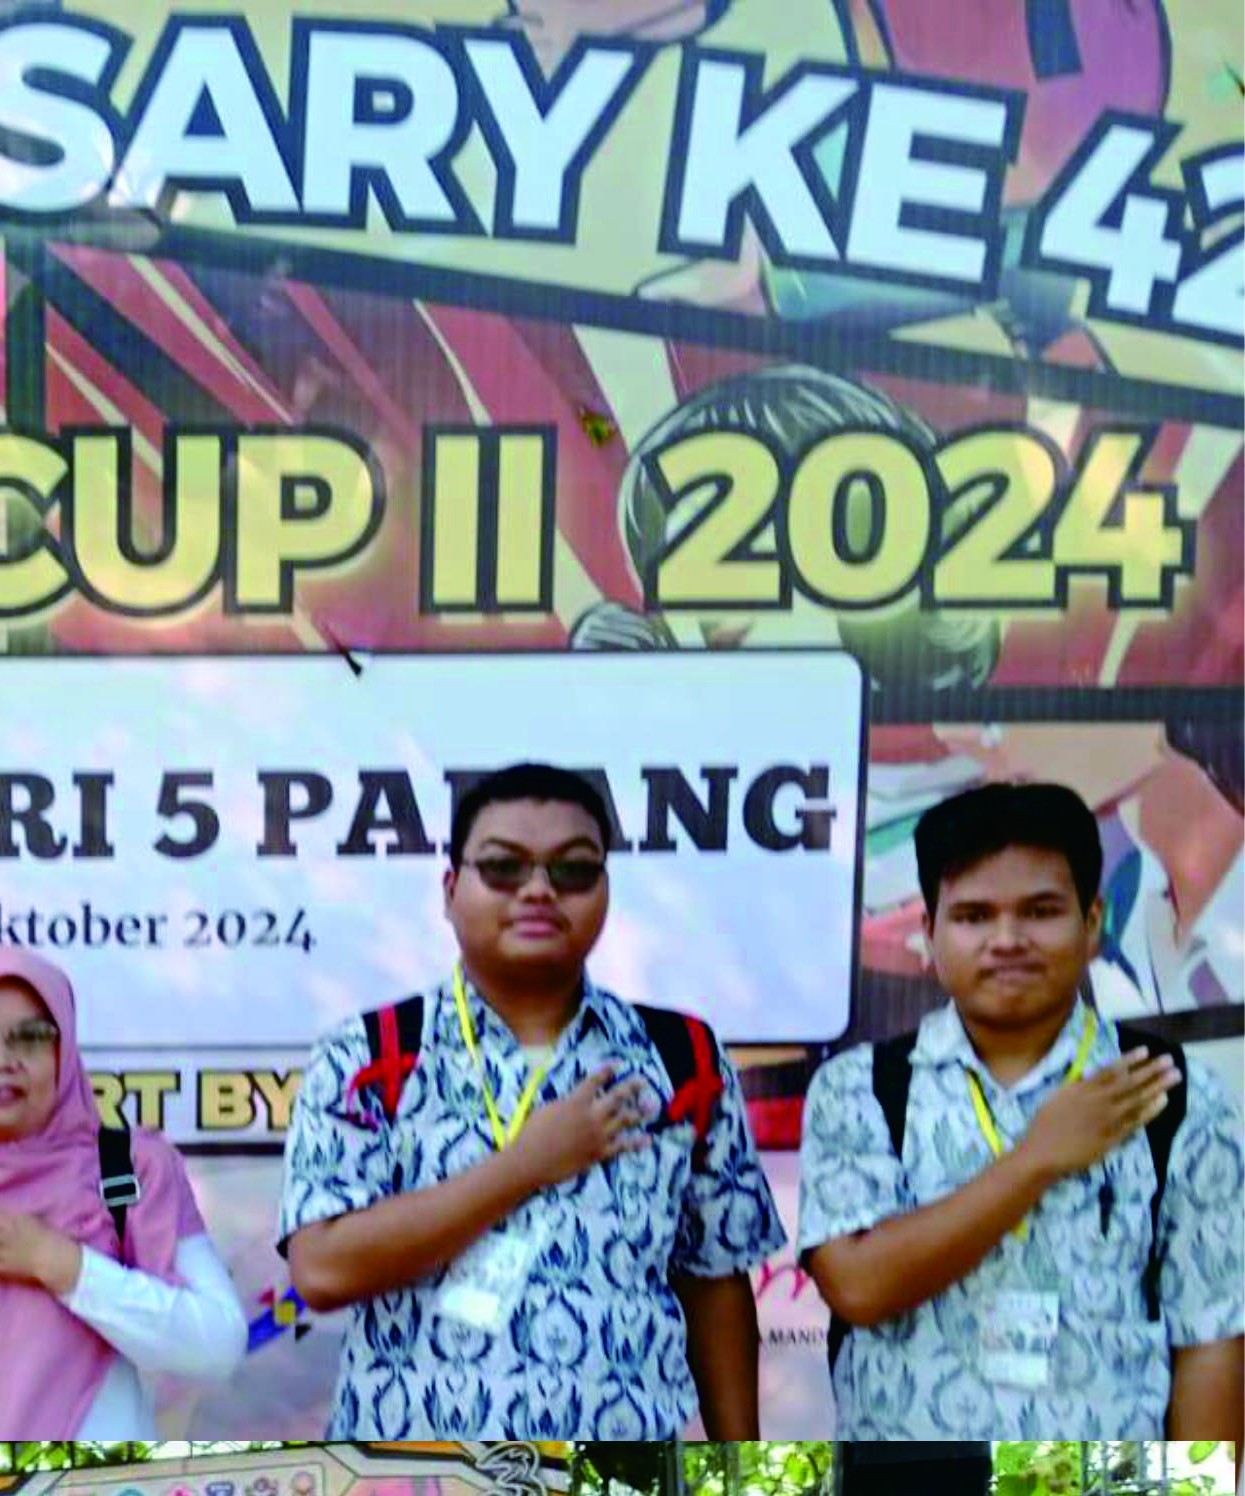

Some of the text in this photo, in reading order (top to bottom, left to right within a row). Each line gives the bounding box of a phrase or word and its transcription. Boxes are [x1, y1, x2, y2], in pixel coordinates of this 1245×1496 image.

[662, 40, 1026, 298] KE
[421, 422, 557, 614] II
[645, 421, 1195, 612] 2024
[154, 770, 220, 859] 5
[183, 906, 317, 953] 2024
[197, 1069, 307, 1130] BY
